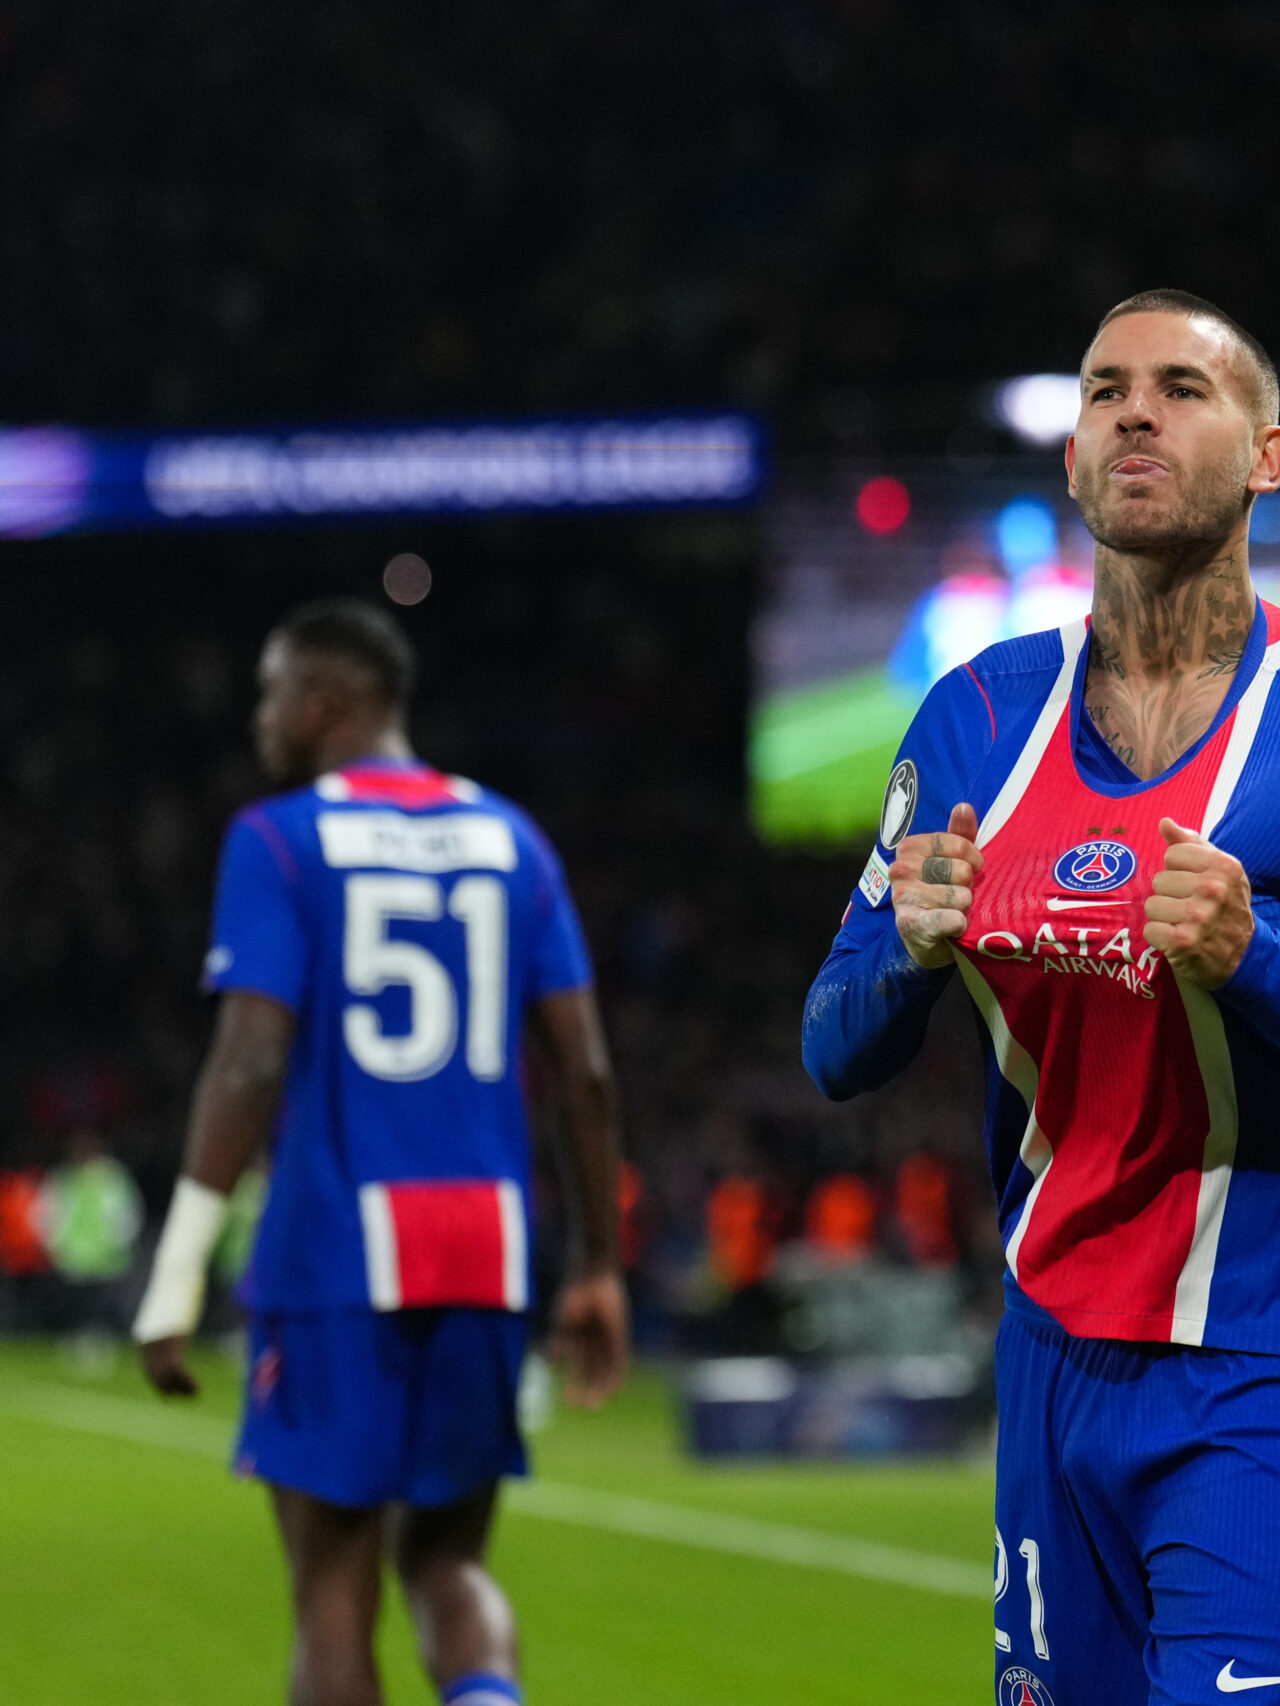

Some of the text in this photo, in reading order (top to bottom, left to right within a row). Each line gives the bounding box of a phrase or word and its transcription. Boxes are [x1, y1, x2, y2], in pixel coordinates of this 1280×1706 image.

[1075, 843, 1126, 857] PARIS
[343, 873, 509, 1083] 51
[1043, 956, 1156, 999] AIRWAYS
[1005, 1669, 1040, 1690] PARIS
